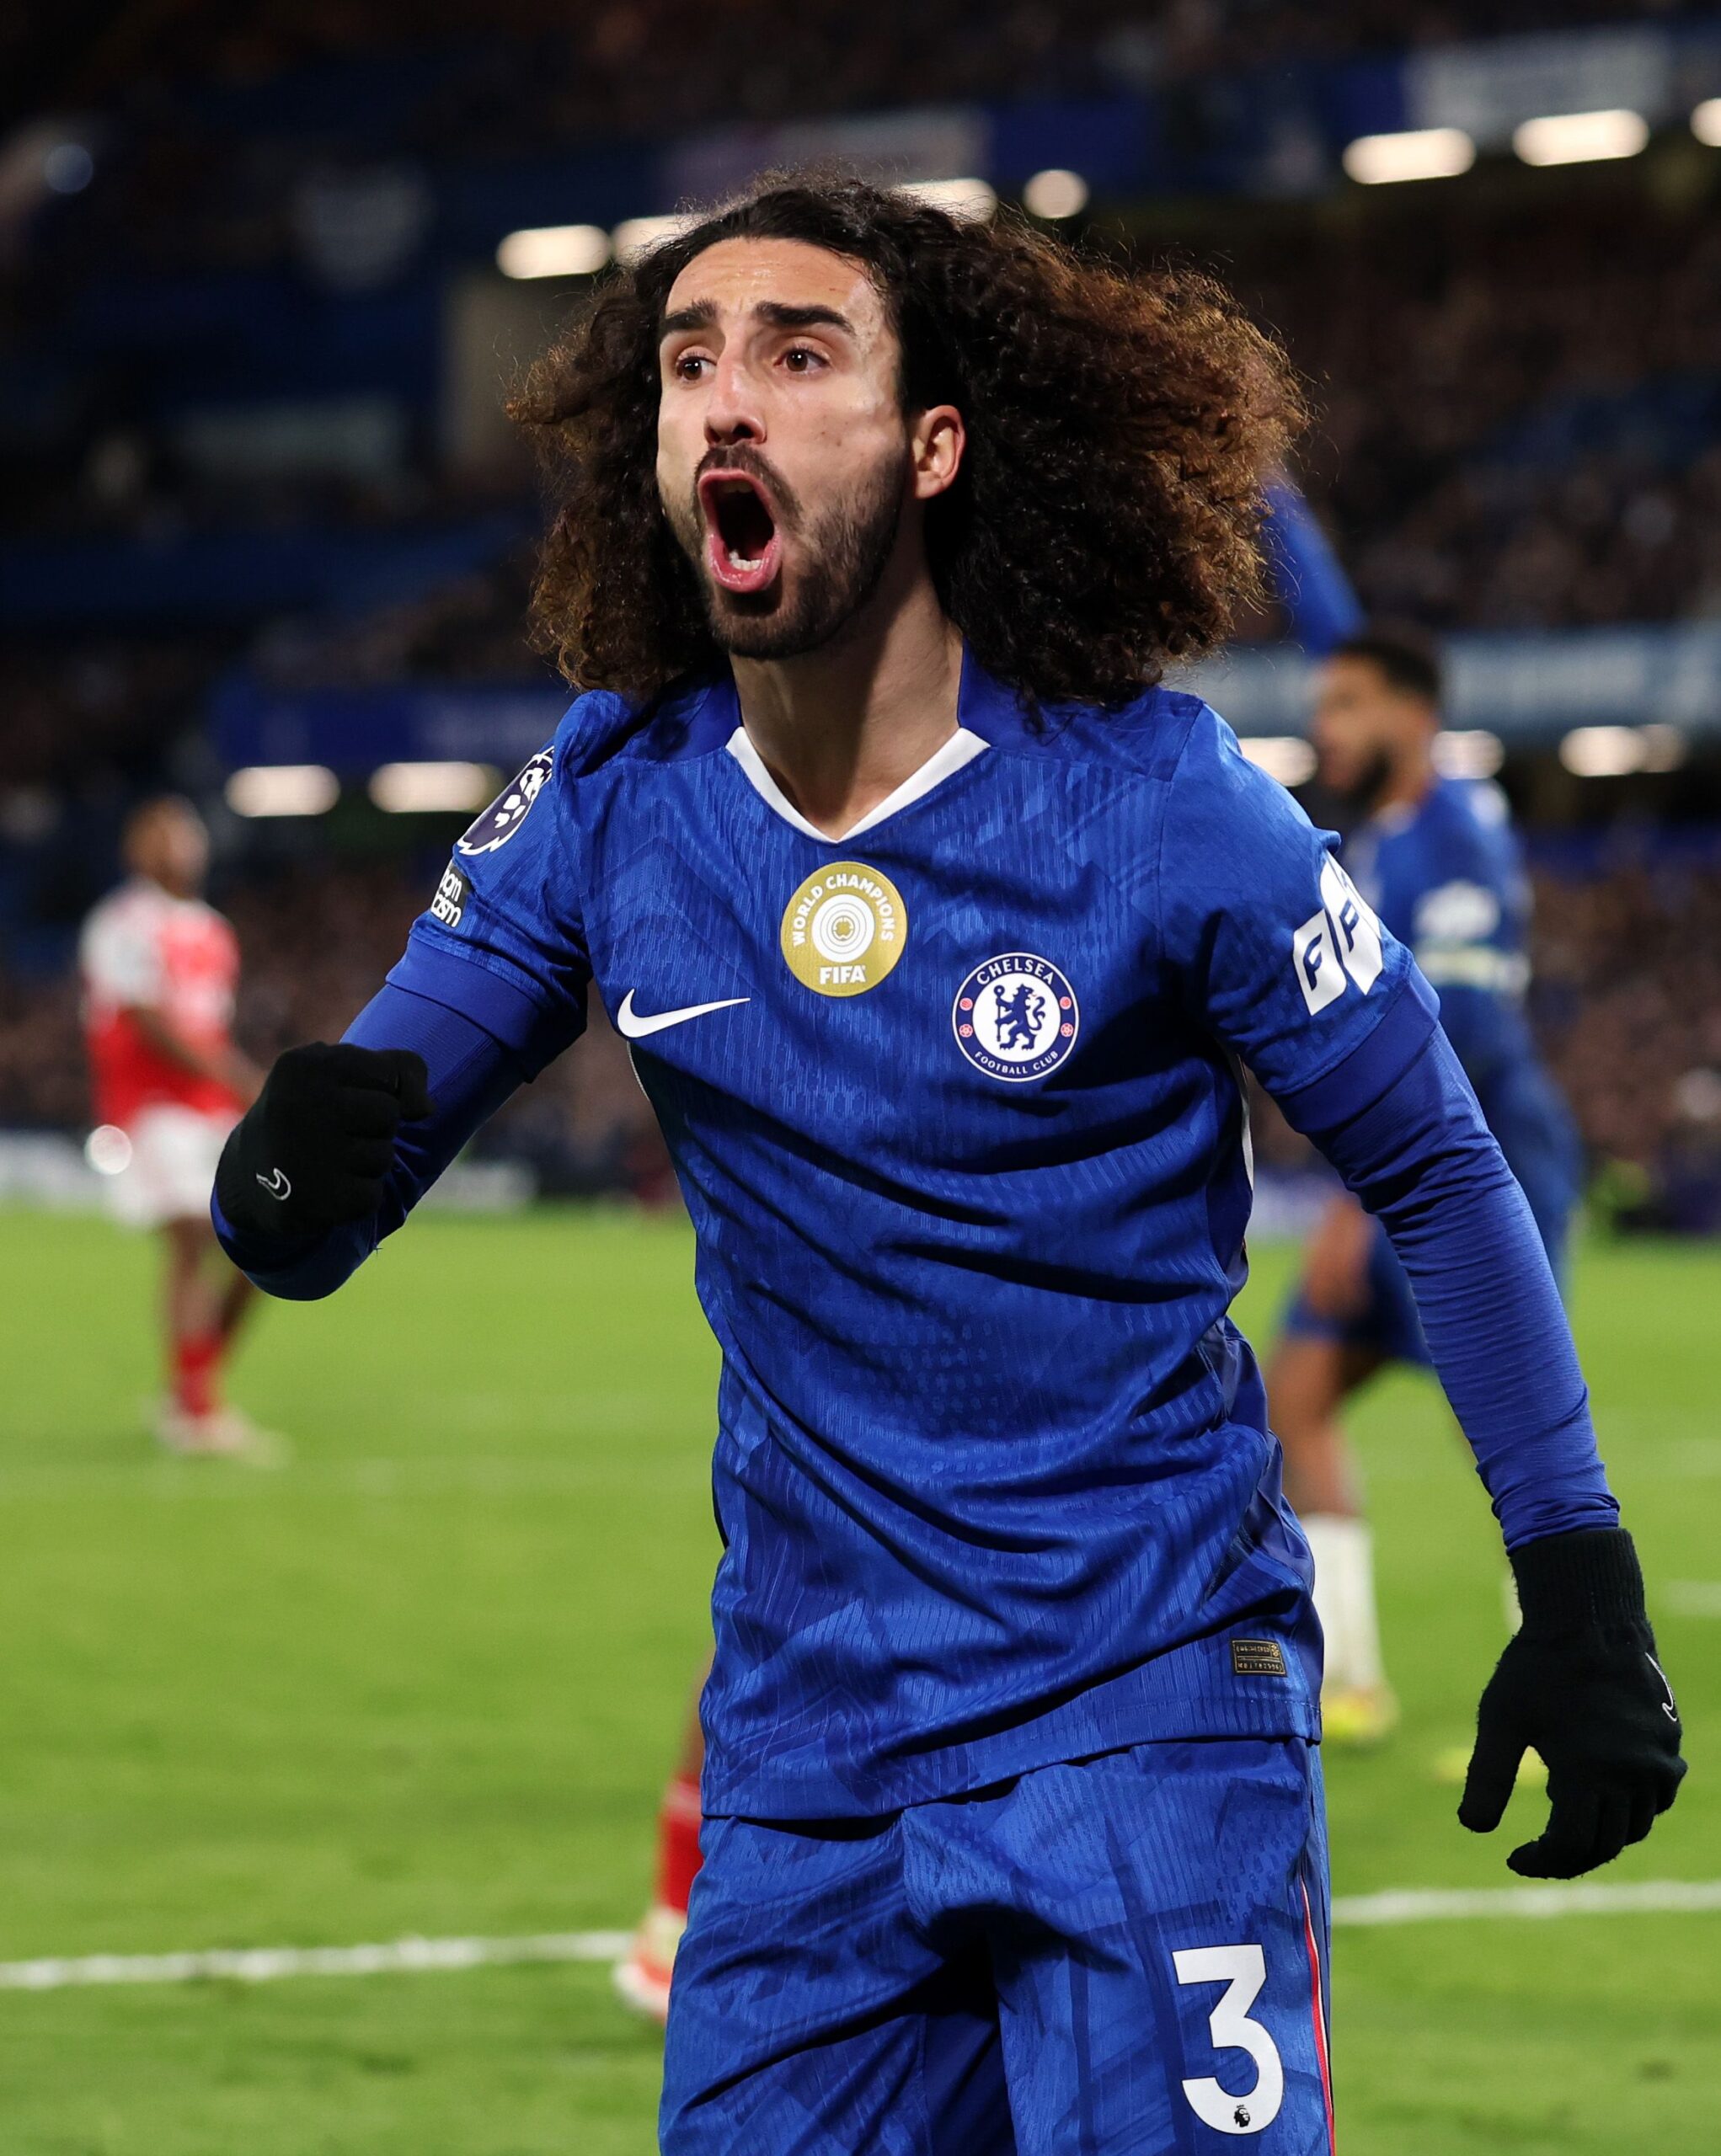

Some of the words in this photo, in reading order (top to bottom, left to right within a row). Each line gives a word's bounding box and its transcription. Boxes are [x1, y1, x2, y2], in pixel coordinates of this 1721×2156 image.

[792, 885, 824, 947] WORLD
[826, 873, 896, 942] CHAMPIONS
[819, 965, 866, 985] FIFA
[975, 958, 1055, 985] CHELSEA
[974, 1051, 1029, 1075] FOOTBALL
[1032, 1050, 1059, 1071] CLUB
[1172, 1944, 1284, 2135] 3
